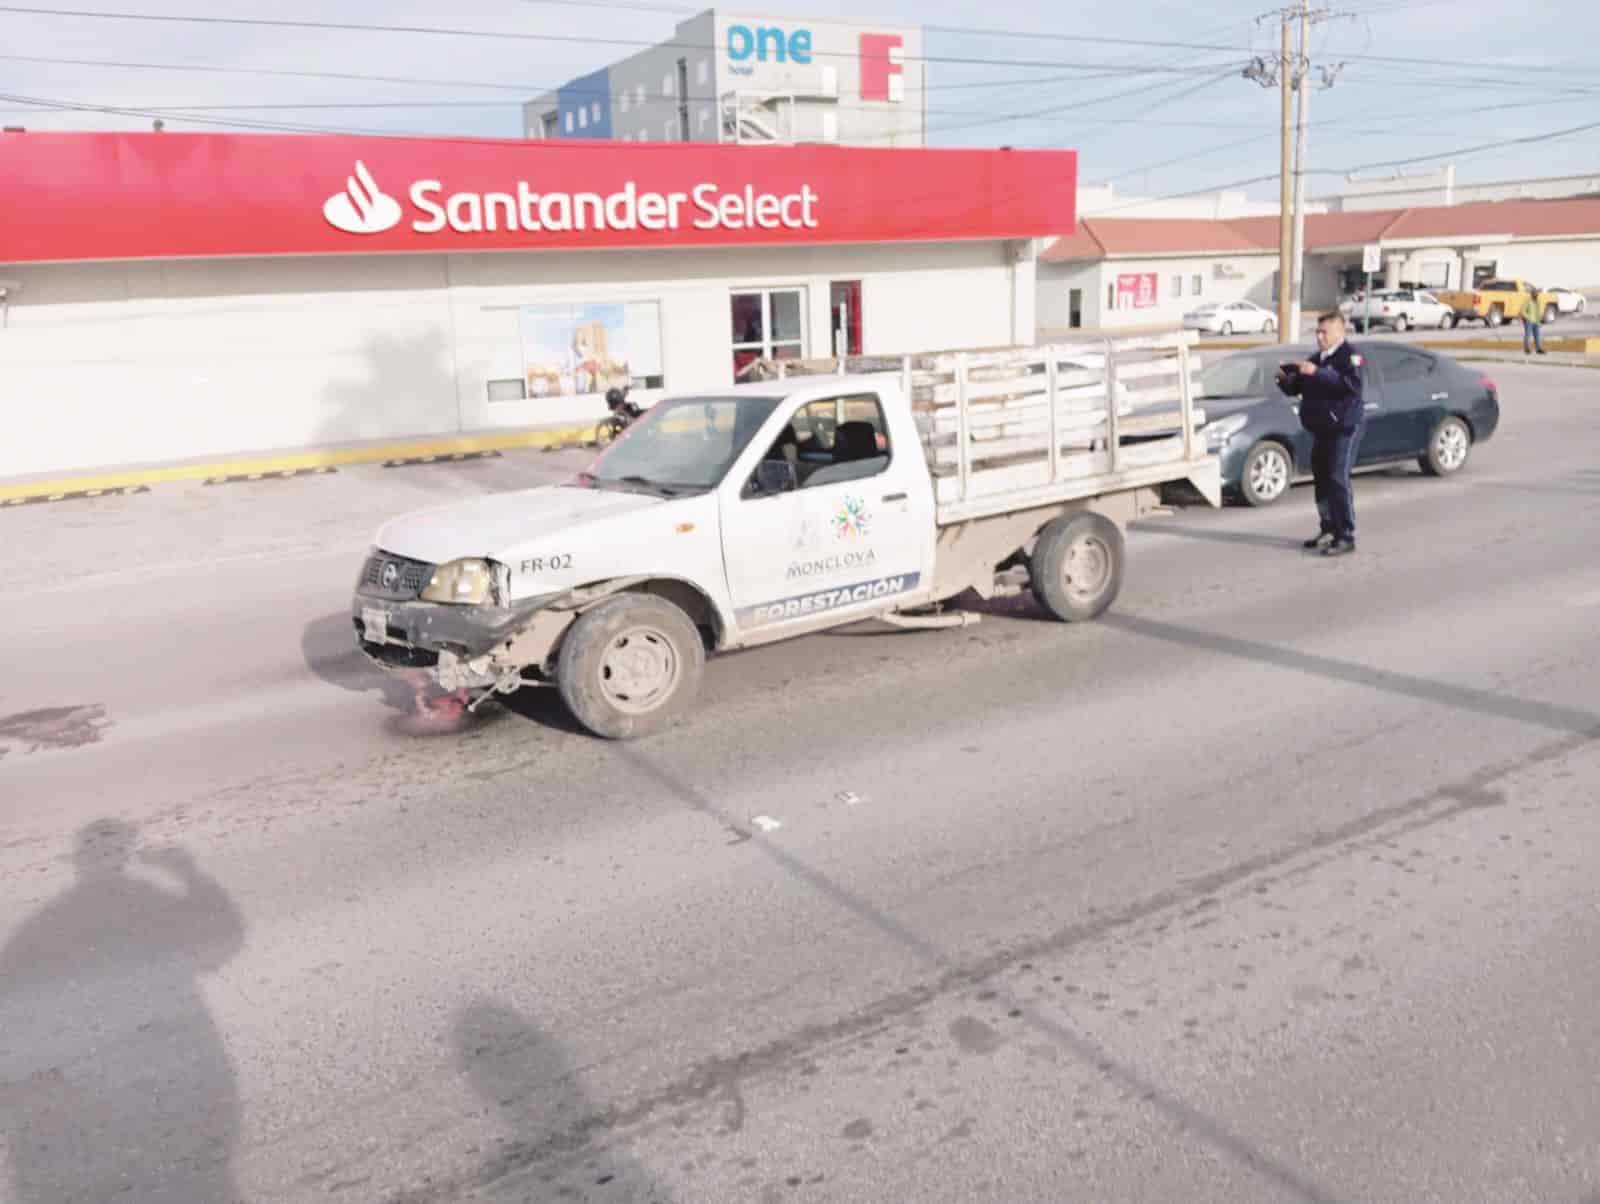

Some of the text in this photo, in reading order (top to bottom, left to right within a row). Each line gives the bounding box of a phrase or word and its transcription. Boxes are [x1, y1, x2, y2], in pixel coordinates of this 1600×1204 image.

[727, 24, 812, 64] one
[411, 179, 818, 232] Santander Select
[520, 553, 574, 574] FR-02
[786, 548, 876, 579] MONCLOVA
